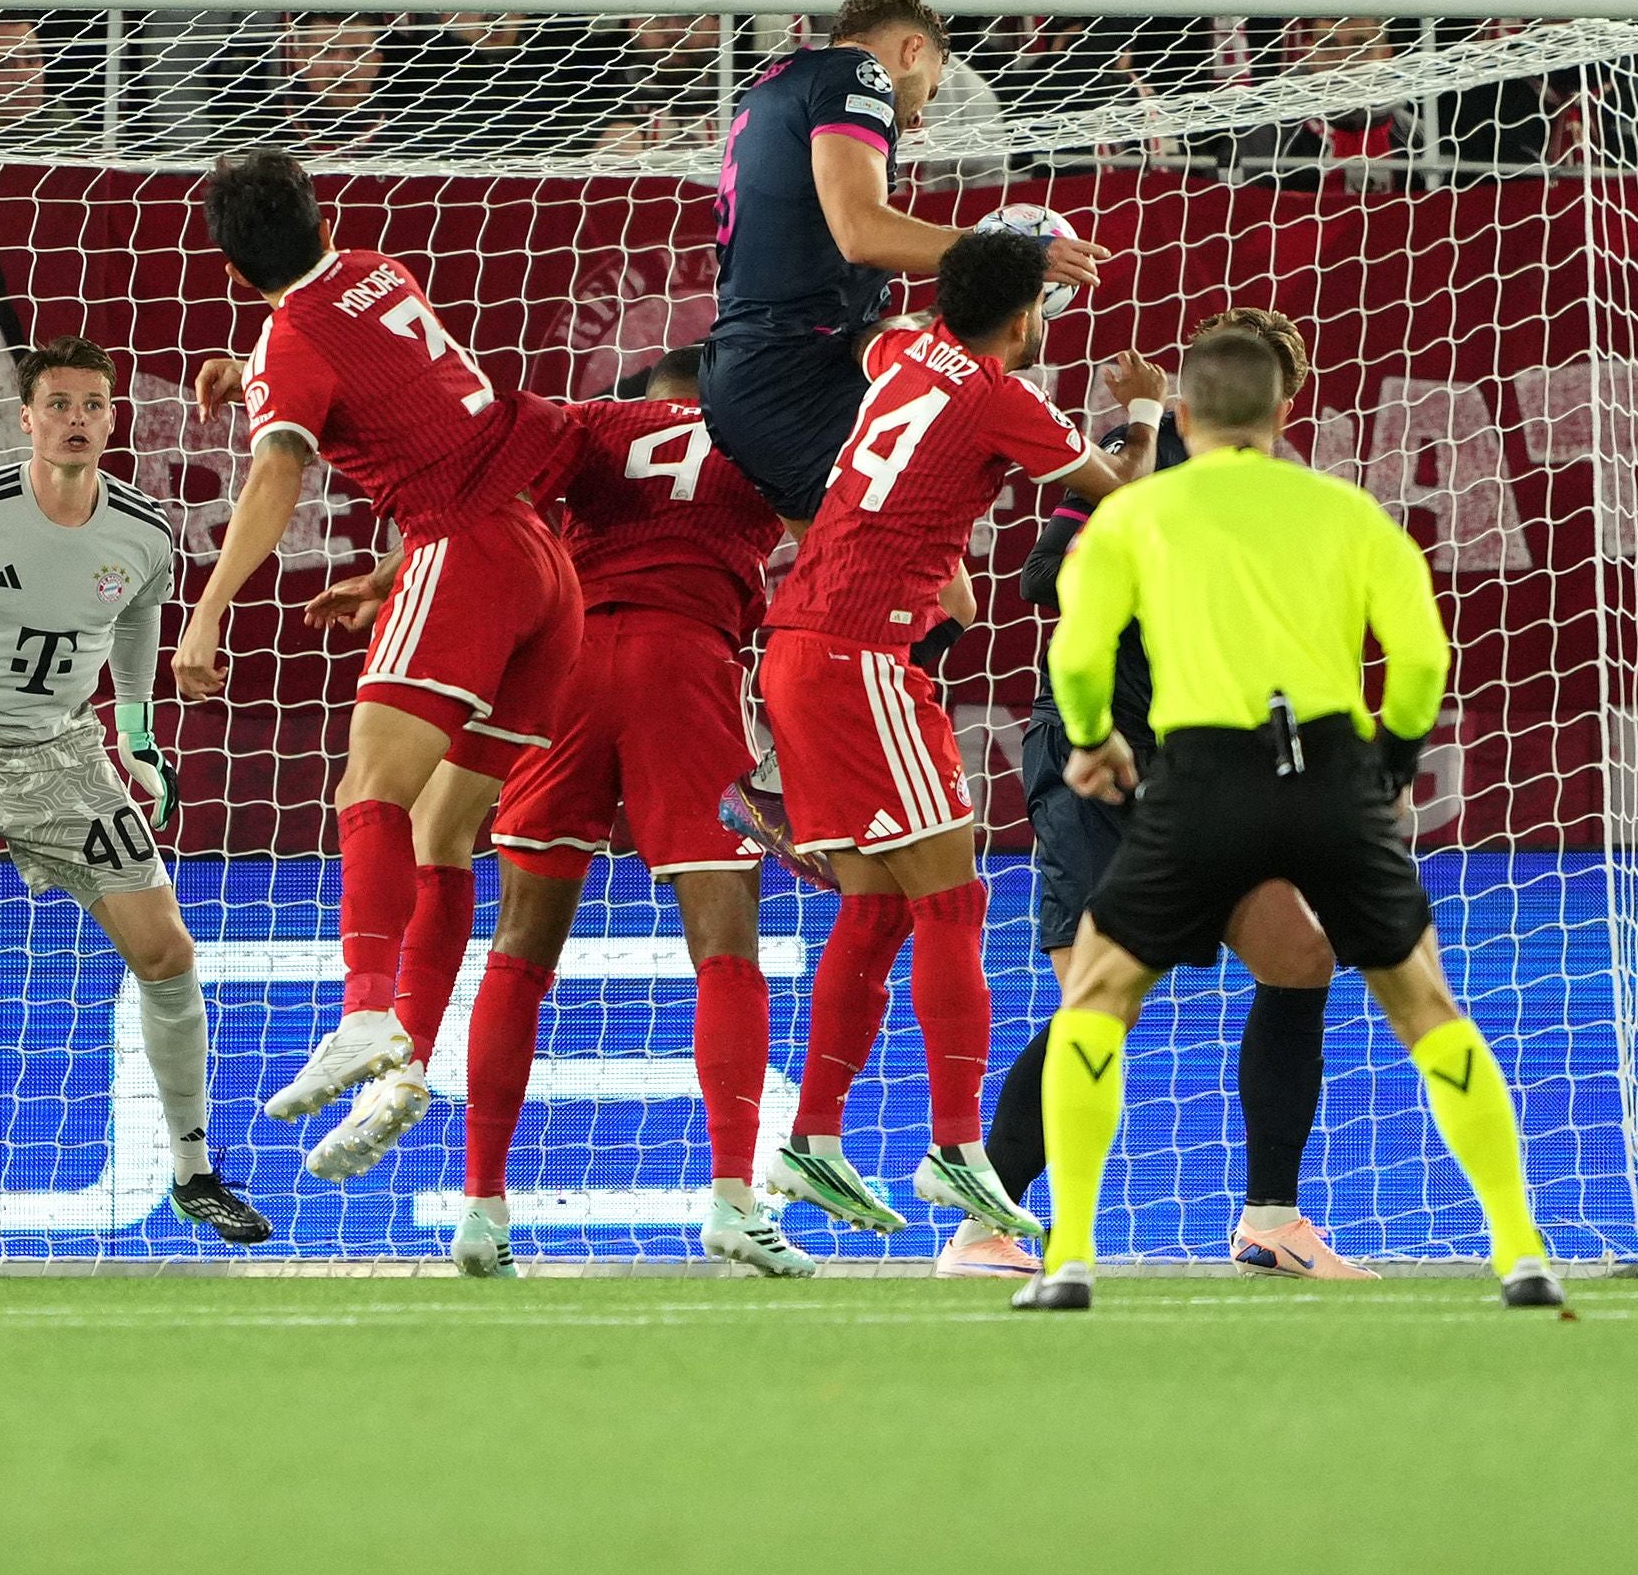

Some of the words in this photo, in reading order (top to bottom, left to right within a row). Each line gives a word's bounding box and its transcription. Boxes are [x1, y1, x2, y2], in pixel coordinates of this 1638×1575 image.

[331, 262, 406, 319] MINJAE
[378, 295, 497, 418] 3
[929, 340, 981, 387] DÍAZ
[666, 402, 702, 417] TA
[623, 421, 714, 502] 4
[9, 625, 80, 696] T
[81, 805, 155, 871] 40
